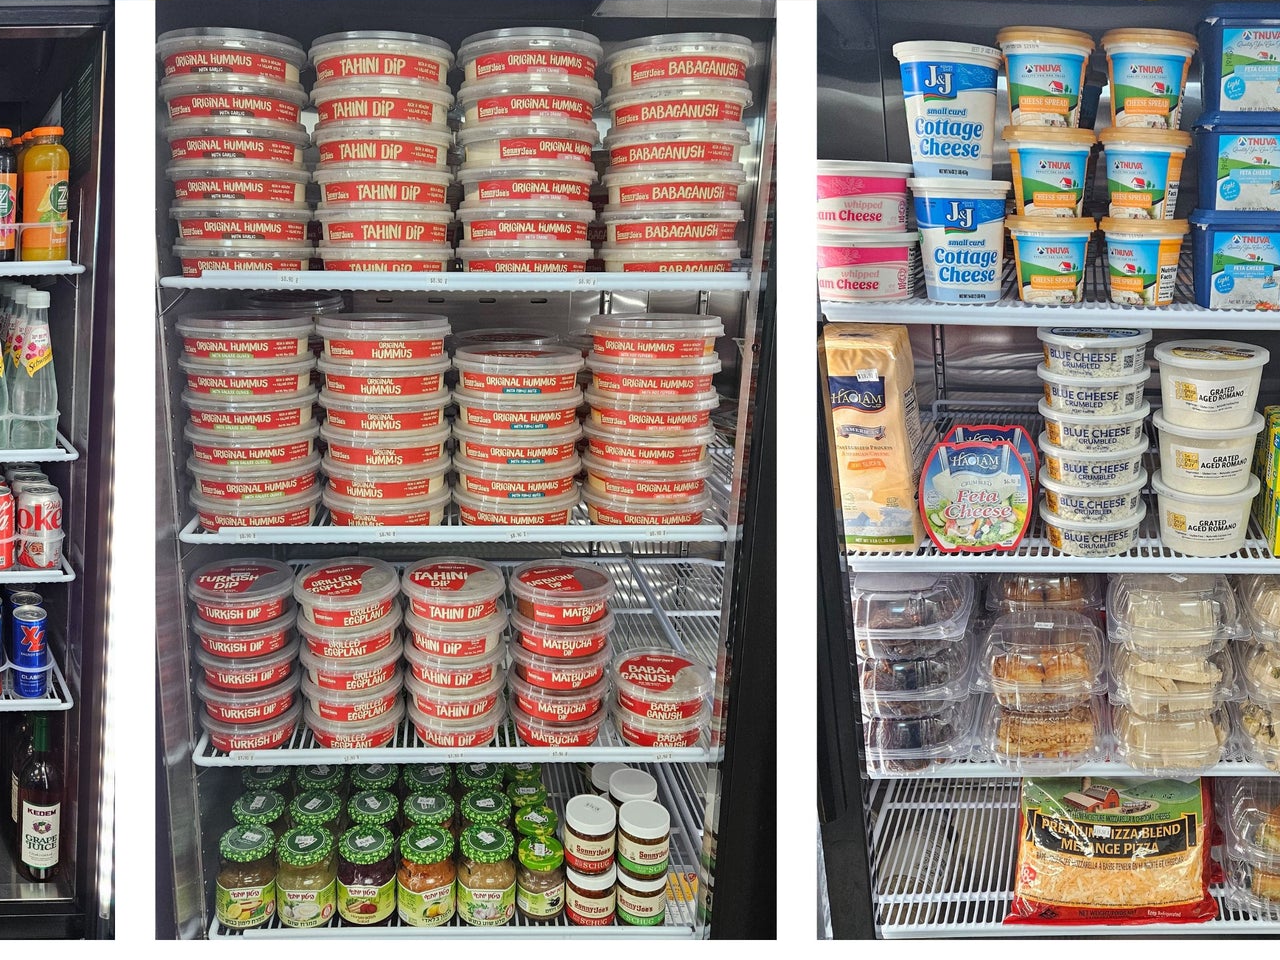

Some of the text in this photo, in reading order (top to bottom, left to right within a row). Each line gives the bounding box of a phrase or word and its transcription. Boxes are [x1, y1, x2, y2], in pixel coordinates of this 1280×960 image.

[339, 58, 379, 76] TAHINI
[549, 55, 582, 68] HUMMUS
[668, 61, 738, 77] BABAGANUSH
[1034, 64, 1061, 73] TNUVA
[1244, 65, 1258, 73] FETA
[925, 65, 952, 94] J&J
[640, 103, 720, 121] BABAGANUSH
[927, 107, 966, 116] small curd
[915, 118, 983, 140] Cottage
[920, 140, 980, 158] Cheese
[844, 201, 883, 210] whipped
[934, 248, 997, 267] Cottage
[939, 266, 995, 283] Cheese
[1050, 351, 1117, 363] BLUE CHEESE
[1062, 361, 1100, 370] CRUMBLED
[956, 489, 997, 504] Feta
[945, 502, 1012, 519] Cheese
[1208, 523, 1237, 531] ROMANO
[429, 607, 464, 618] TAHINI
[543, 639, 592, 650] MATBUCHA
[28, 808, 57, 816] KEDEM
[1141, 824, 1181, 839] BLEND
[26, 835, 57, 844] GRAPE
